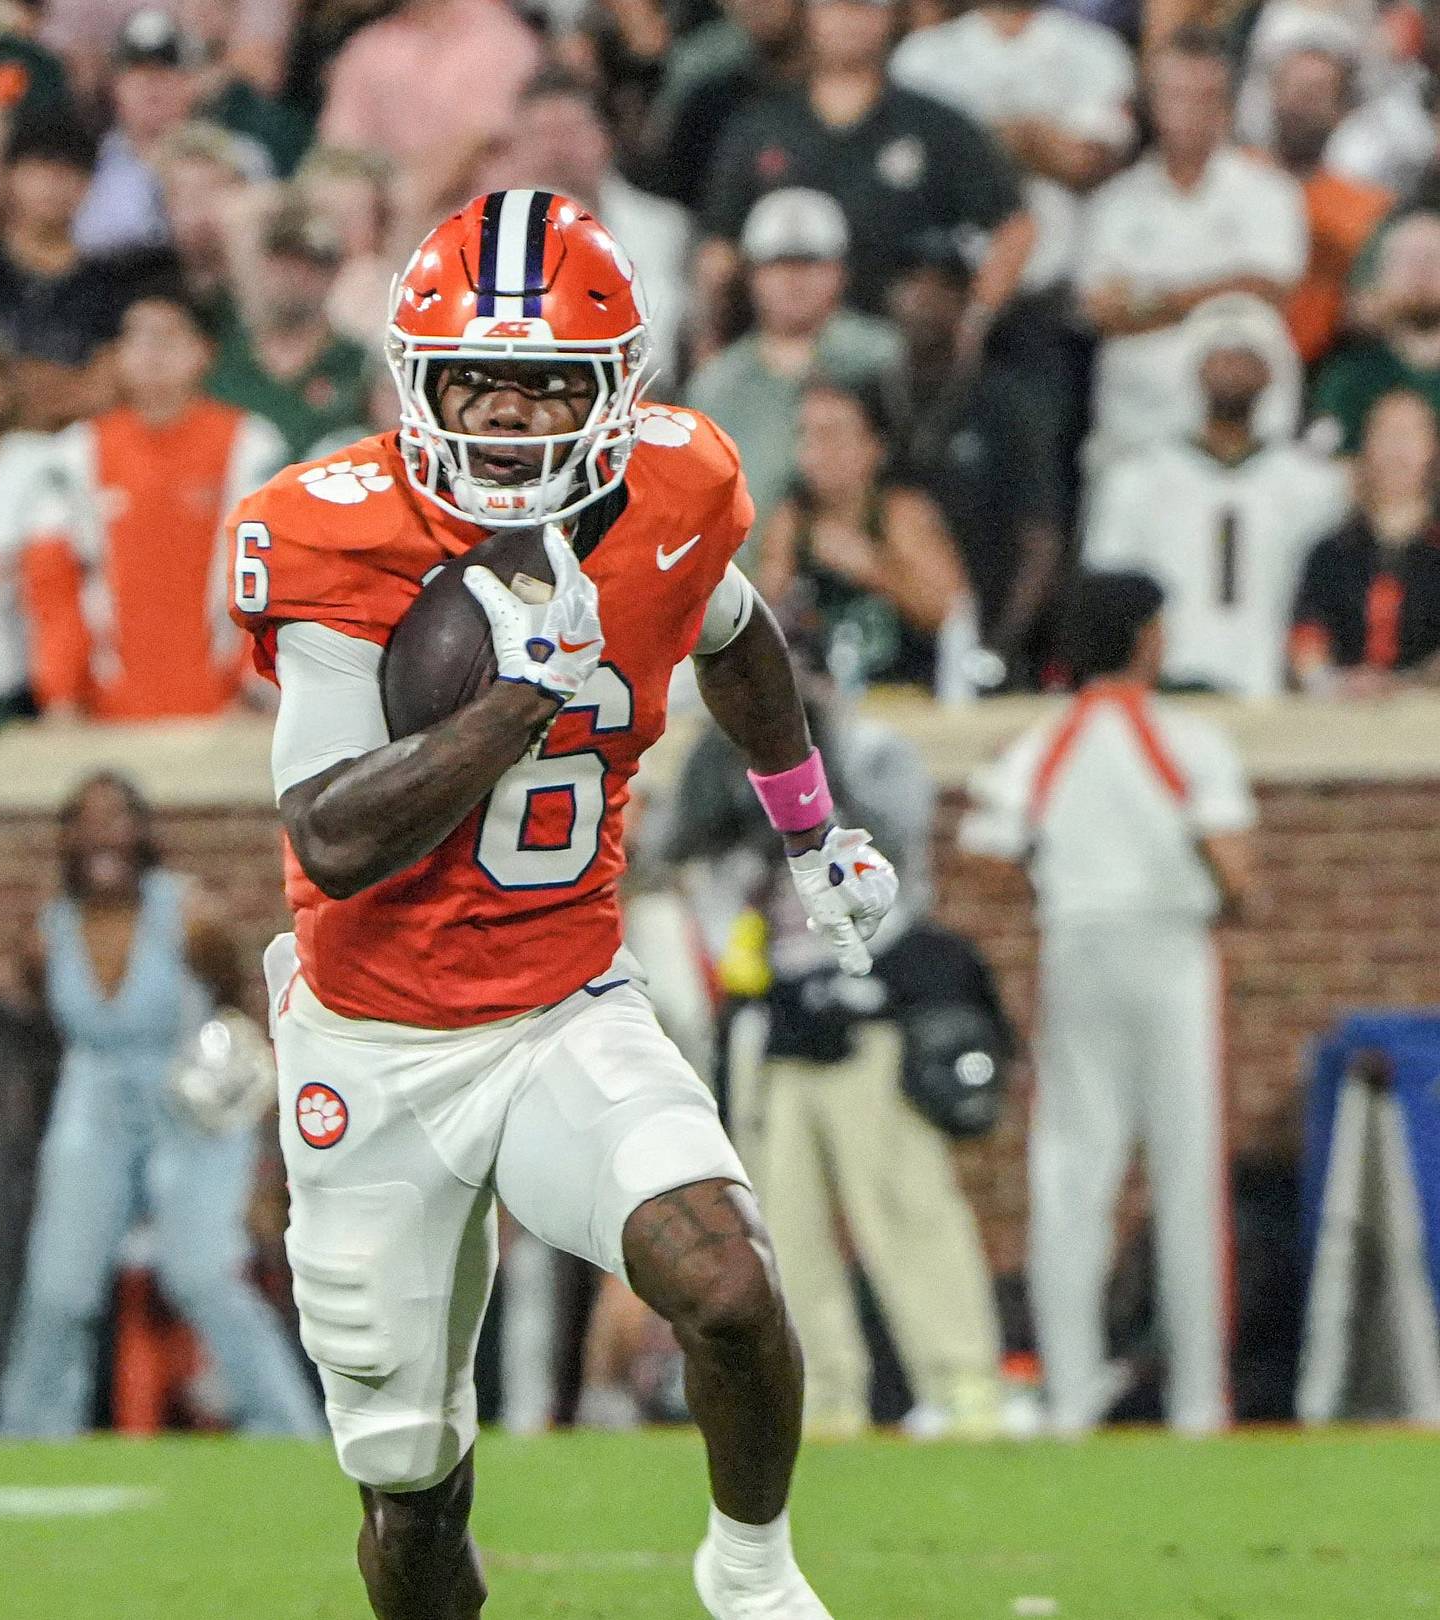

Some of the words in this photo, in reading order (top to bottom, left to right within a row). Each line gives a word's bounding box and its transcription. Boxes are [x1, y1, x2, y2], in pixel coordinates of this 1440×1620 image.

[482, 321, 533, 338] ACC
[486, 496, 509, 509] ALL
[512, 496, 526, 509] IN
[233, 520, 272, 614] 6
[474, 661, 634, 892] 6
